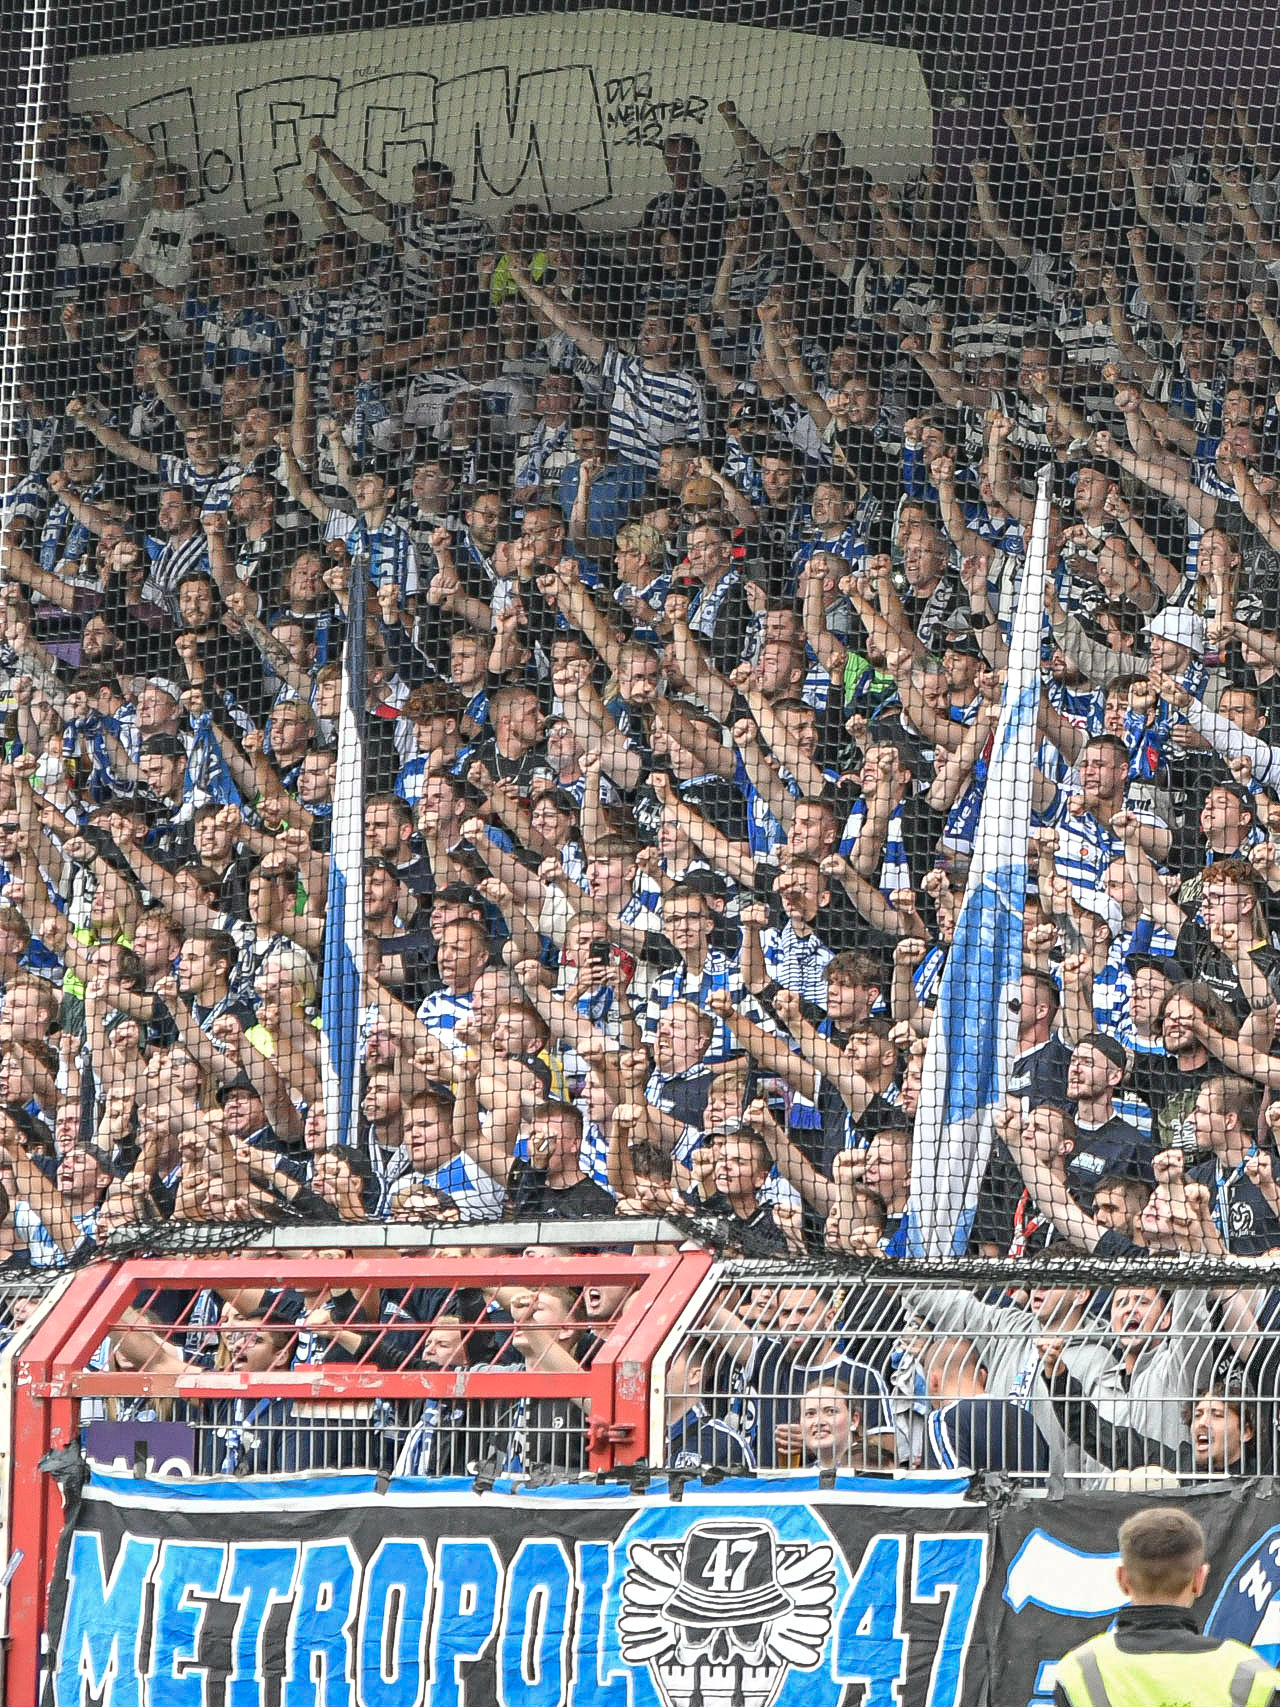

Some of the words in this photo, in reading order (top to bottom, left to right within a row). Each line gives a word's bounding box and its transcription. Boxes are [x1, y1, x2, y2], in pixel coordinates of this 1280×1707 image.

[54, 1530, 648, 1707] METROPOL
[832, 1531, 991, 1707] 47
[702, 1539, 760, 1592] 47
